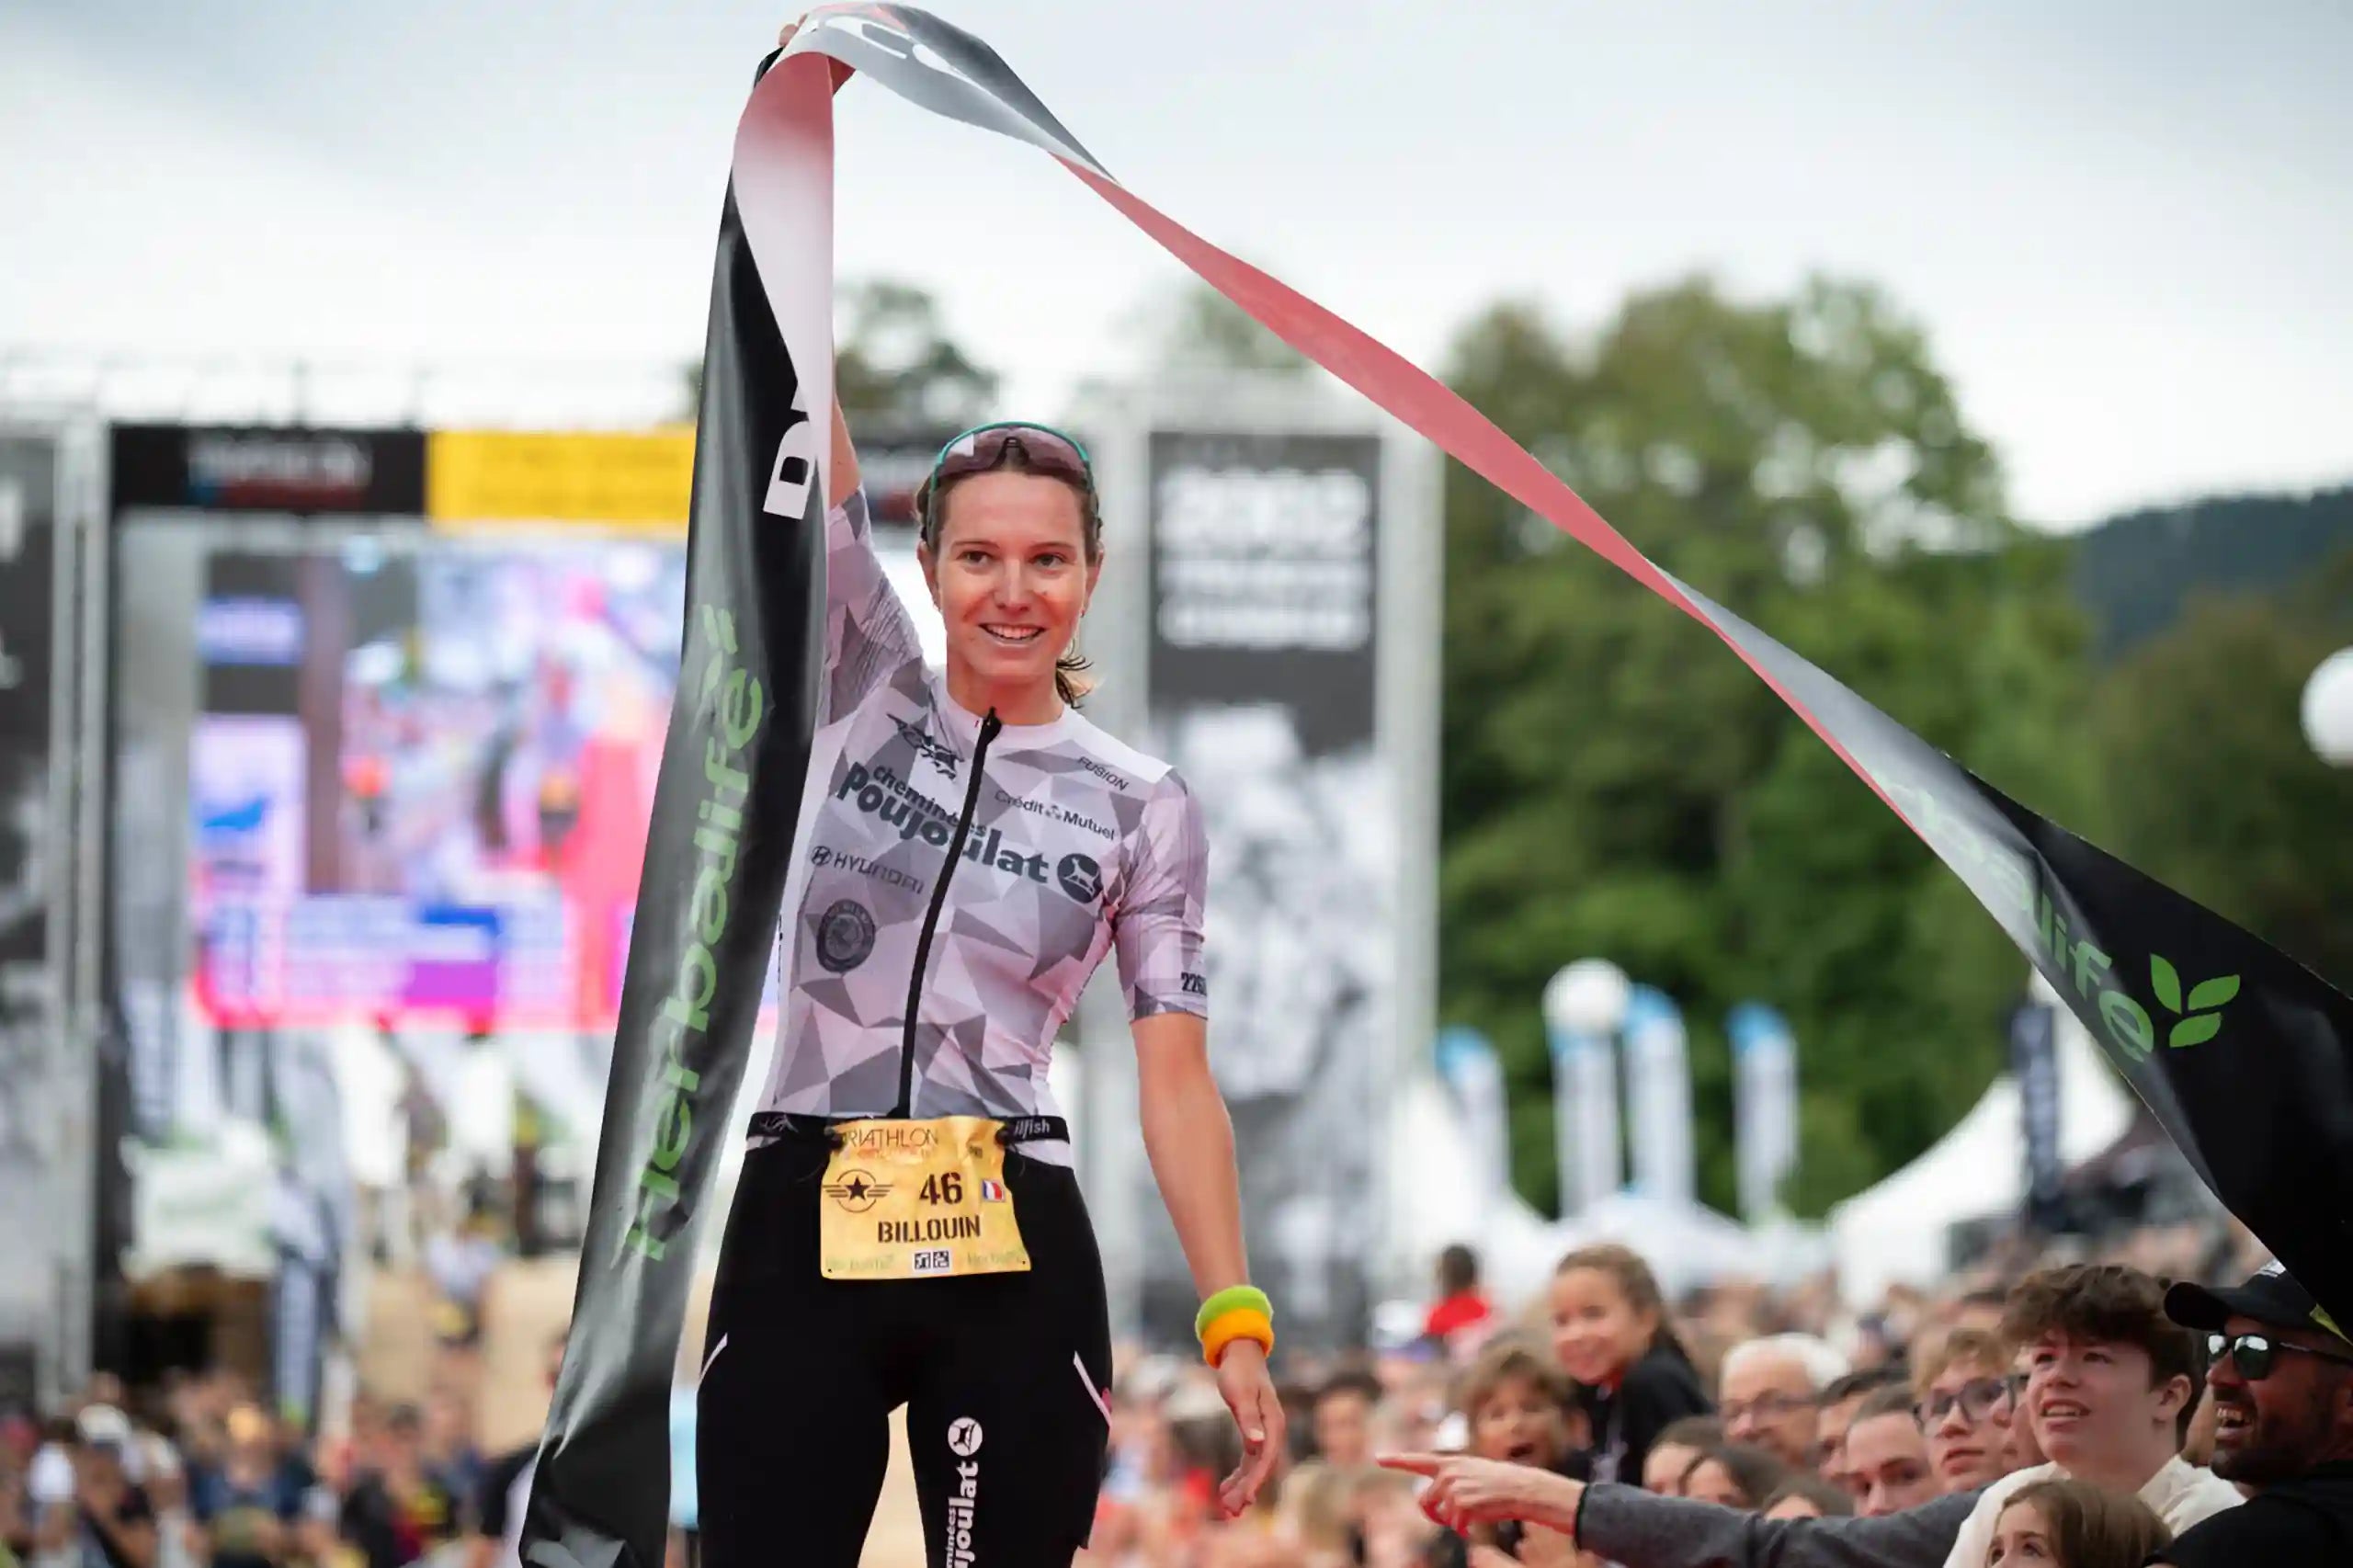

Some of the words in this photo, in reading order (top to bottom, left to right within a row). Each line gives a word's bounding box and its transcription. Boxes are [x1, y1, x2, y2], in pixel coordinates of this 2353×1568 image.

[1077, 756, 1130, 791] FUSION
[873, 765, 987, 837] cheminés
[994, 790, 1044, 815] Crédit
[1063, 811, 1115, 840] Mutuel
[834, 852, 925, 894] HYUNDAI
[918, 1172, 962, 1206] 46
[878, 1214, 981, 1244] BILLOUIN
